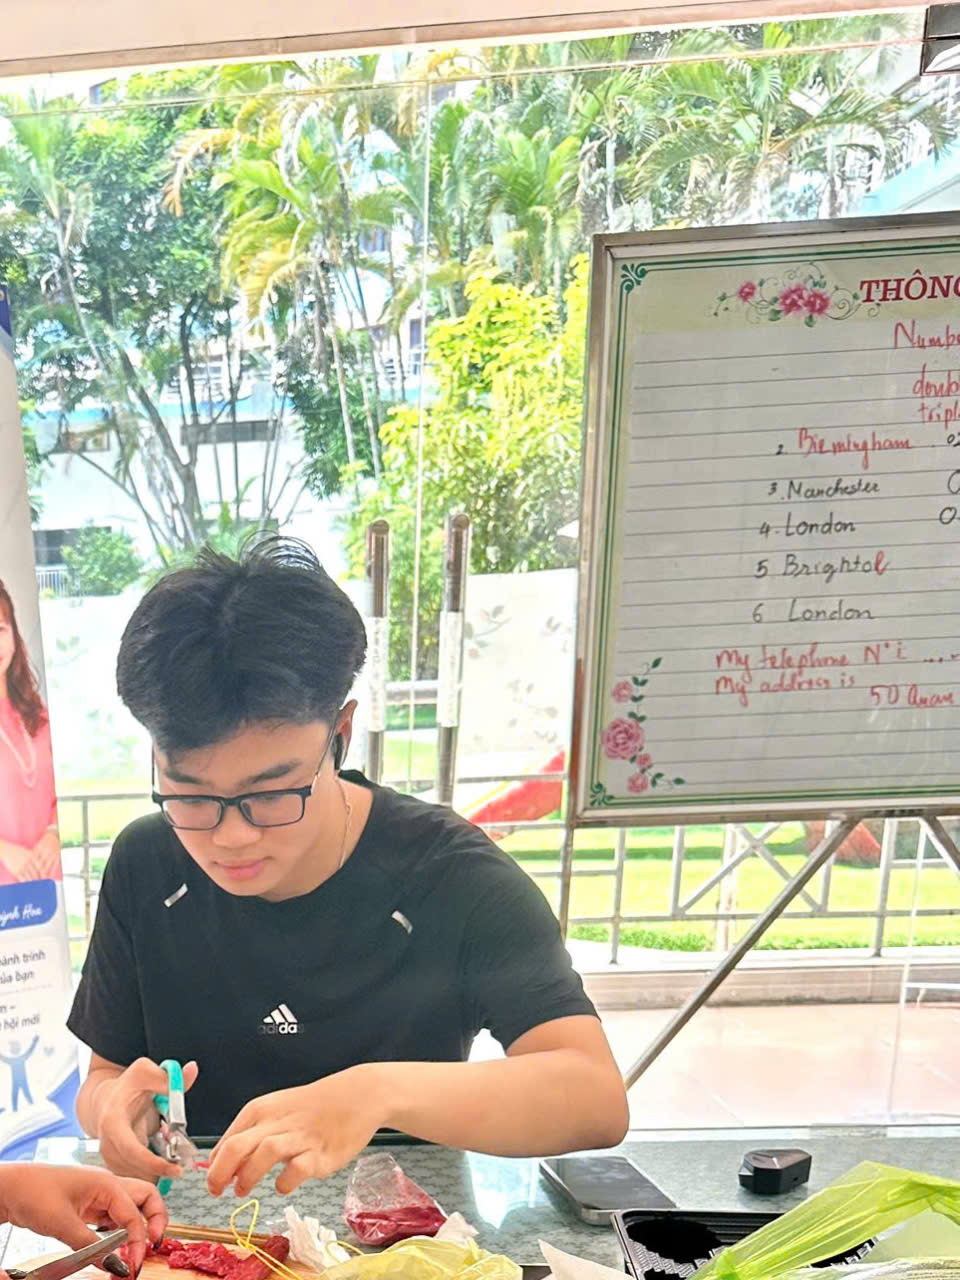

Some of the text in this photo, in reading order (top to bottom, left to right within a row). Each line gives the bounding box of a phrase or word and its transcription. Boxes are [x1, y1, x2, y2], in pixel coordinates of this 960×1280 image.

[785, 511, 856, 537] London
[754, 558, 769, 579] 5
[752, 598, 876, 624] 6 London
[715, 649, 753, 684] My
[714, 674, 749, 708] My
[839, 671, 856, 689] is
[22, 949, 46, 964] trình
[15, 970, 35, 984] bạn
[3, 1016, 19, 1031] hội
[21, 1012, 41, 1027] mới
